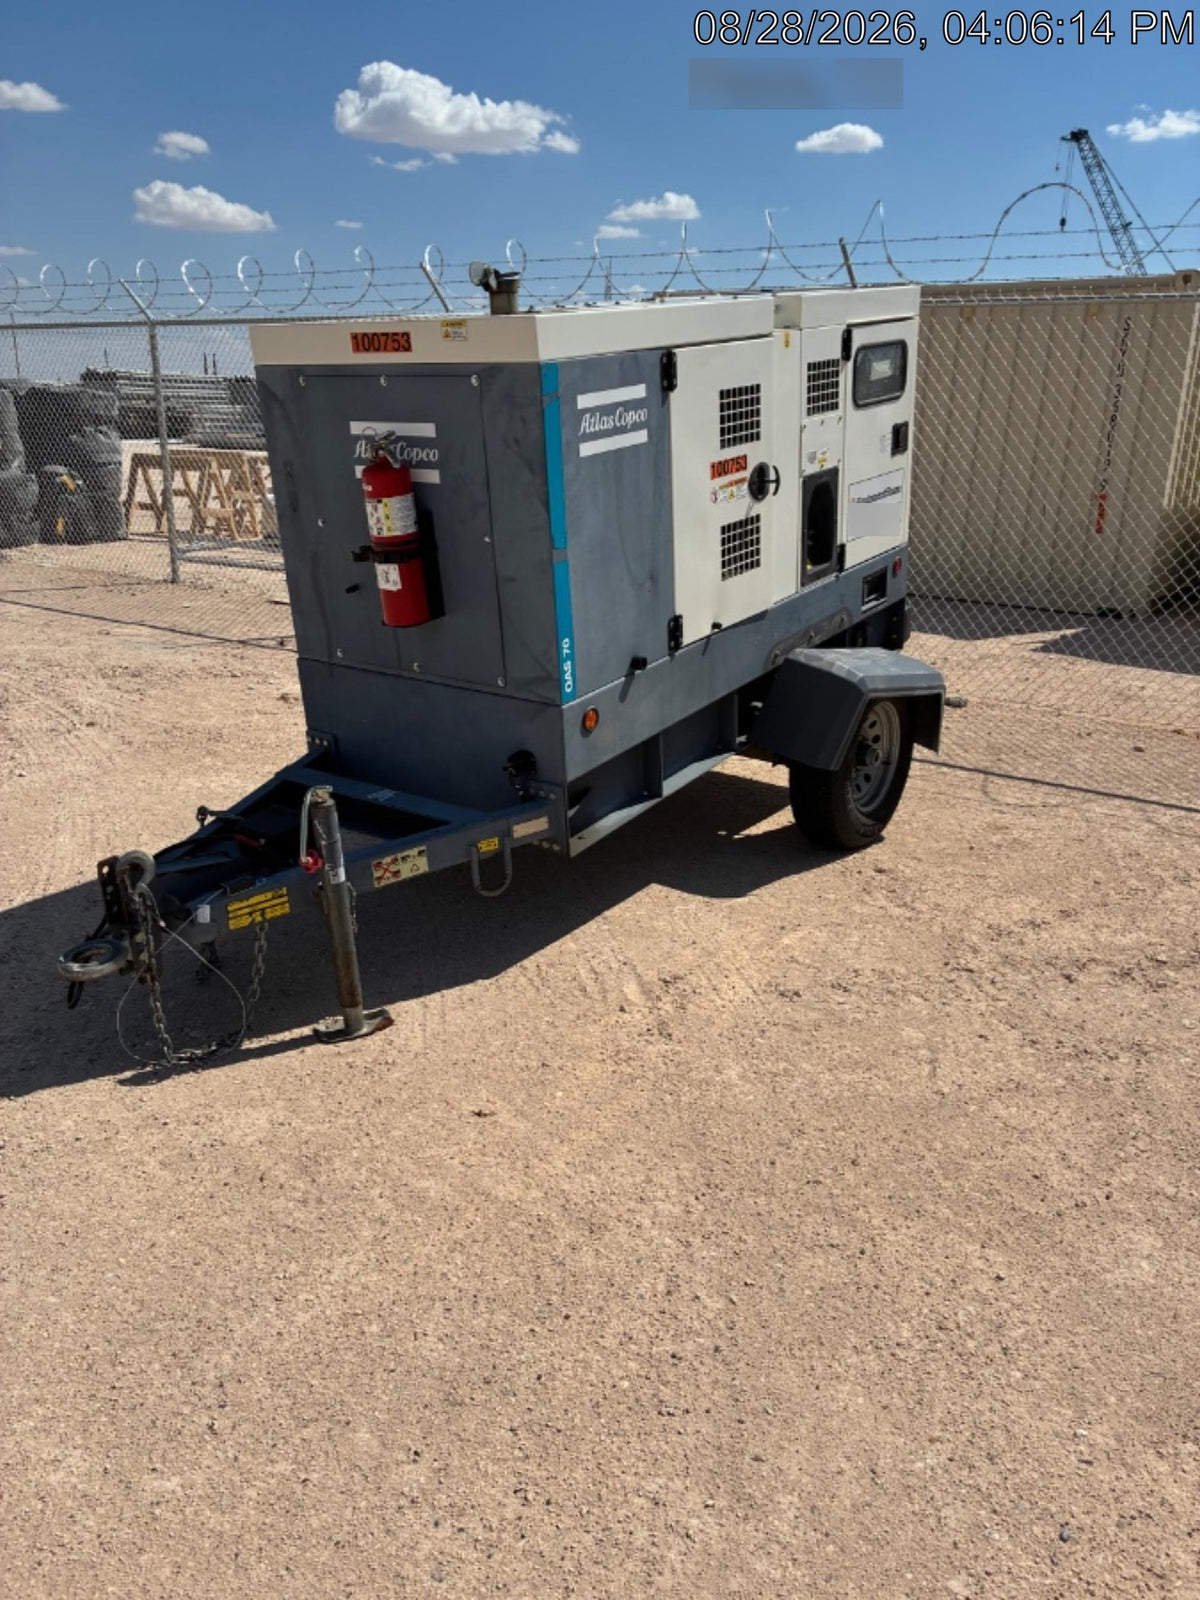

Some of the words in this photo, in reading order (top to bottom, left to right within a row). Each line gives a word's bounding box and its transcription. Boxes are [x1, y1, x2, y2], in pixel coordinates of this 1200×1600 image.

[350, 331, 412, 352] 100753
[578, 411, 615, 436] Atlas
[614, 406, 648, 429] Copco
[396, 441, 439, 465] Copco
[710, 454, 747, 480] 100753
